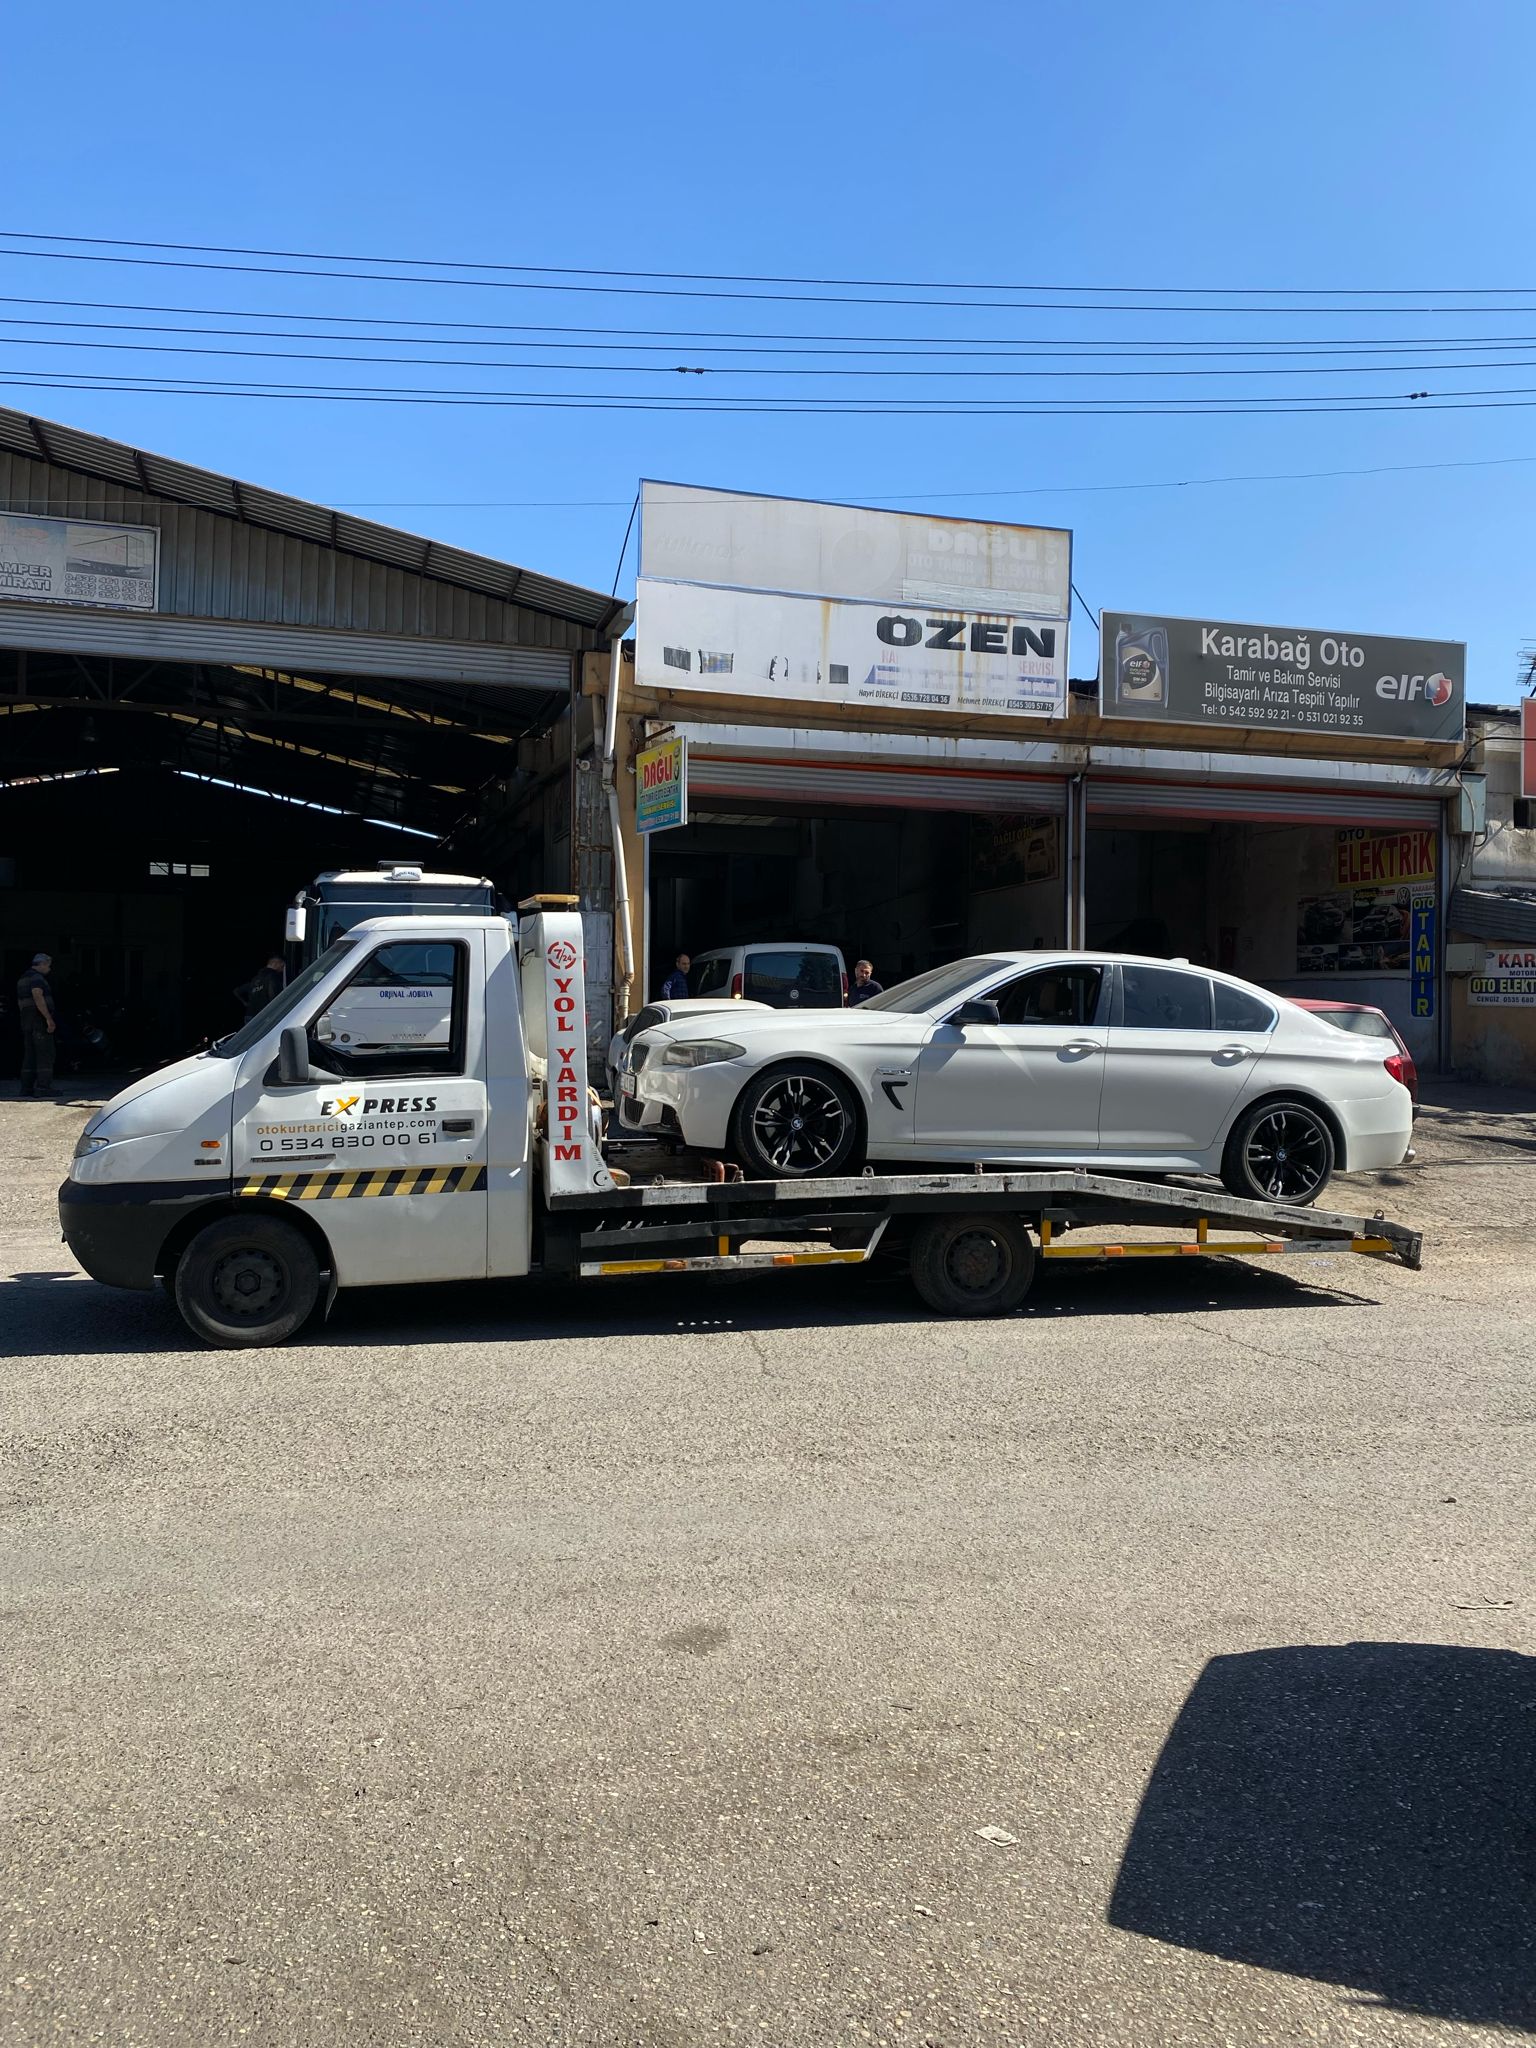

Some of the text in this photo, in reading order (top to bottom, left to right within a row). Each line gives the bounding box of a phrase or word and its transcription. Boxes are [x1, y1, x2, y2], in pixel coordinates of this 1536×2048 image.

[1201, 627, 1365, 670] Karabağ Oto
[1226, 665, 1341, 688] Tamir ve Bakım Servisi
[1375, 675, 1424, 701] elf
[931, 694, 939, 703] 04
[1036, 702, 1044, 710] 57
[1045, 703, 1053, 711] 75
[1205, 682, 1360, 711] Bilgisayarlı Arıza Tespiti Yapılır
[1201, 704, 1218, 715] Tel:
[1220, 706, 1227, 716] 0
[1229, 706, 1246, 717] 542
[1248, 708, 1265, 718] 592
[1267, 709, 1279, 719] 92
[1280, 710, 1290, 720] 21
[1298, 711, 1304, 721] 0
[1306, 712, 1321, 722] 531
[1323, 713, 1338, 723] 021
[1339, 714, 1350, 724] 92
[1352, 715, 1364, 726] 35
[643, 750, 673, 789] DAĞLI
[1339, 828, 1365, 842] OTO
[1337, 831, 1433, 883] ELEKTRİK
[1413, 898, 1435, 909] OTO
[553, 948, 572, 963] 7/24
[1416, 912, 1430, 1016] TAMİR
[1473, 978, 1495, 993] OTO
[554, 978, 582, 1161] YOL YARDIM
[320, 1096, 437, 1119] EXPRESS
[256, 1119, 436, 1135] otokurtaricigaziantep.com
[260, 1132, 437, 1151] 0 534 830 00 61
